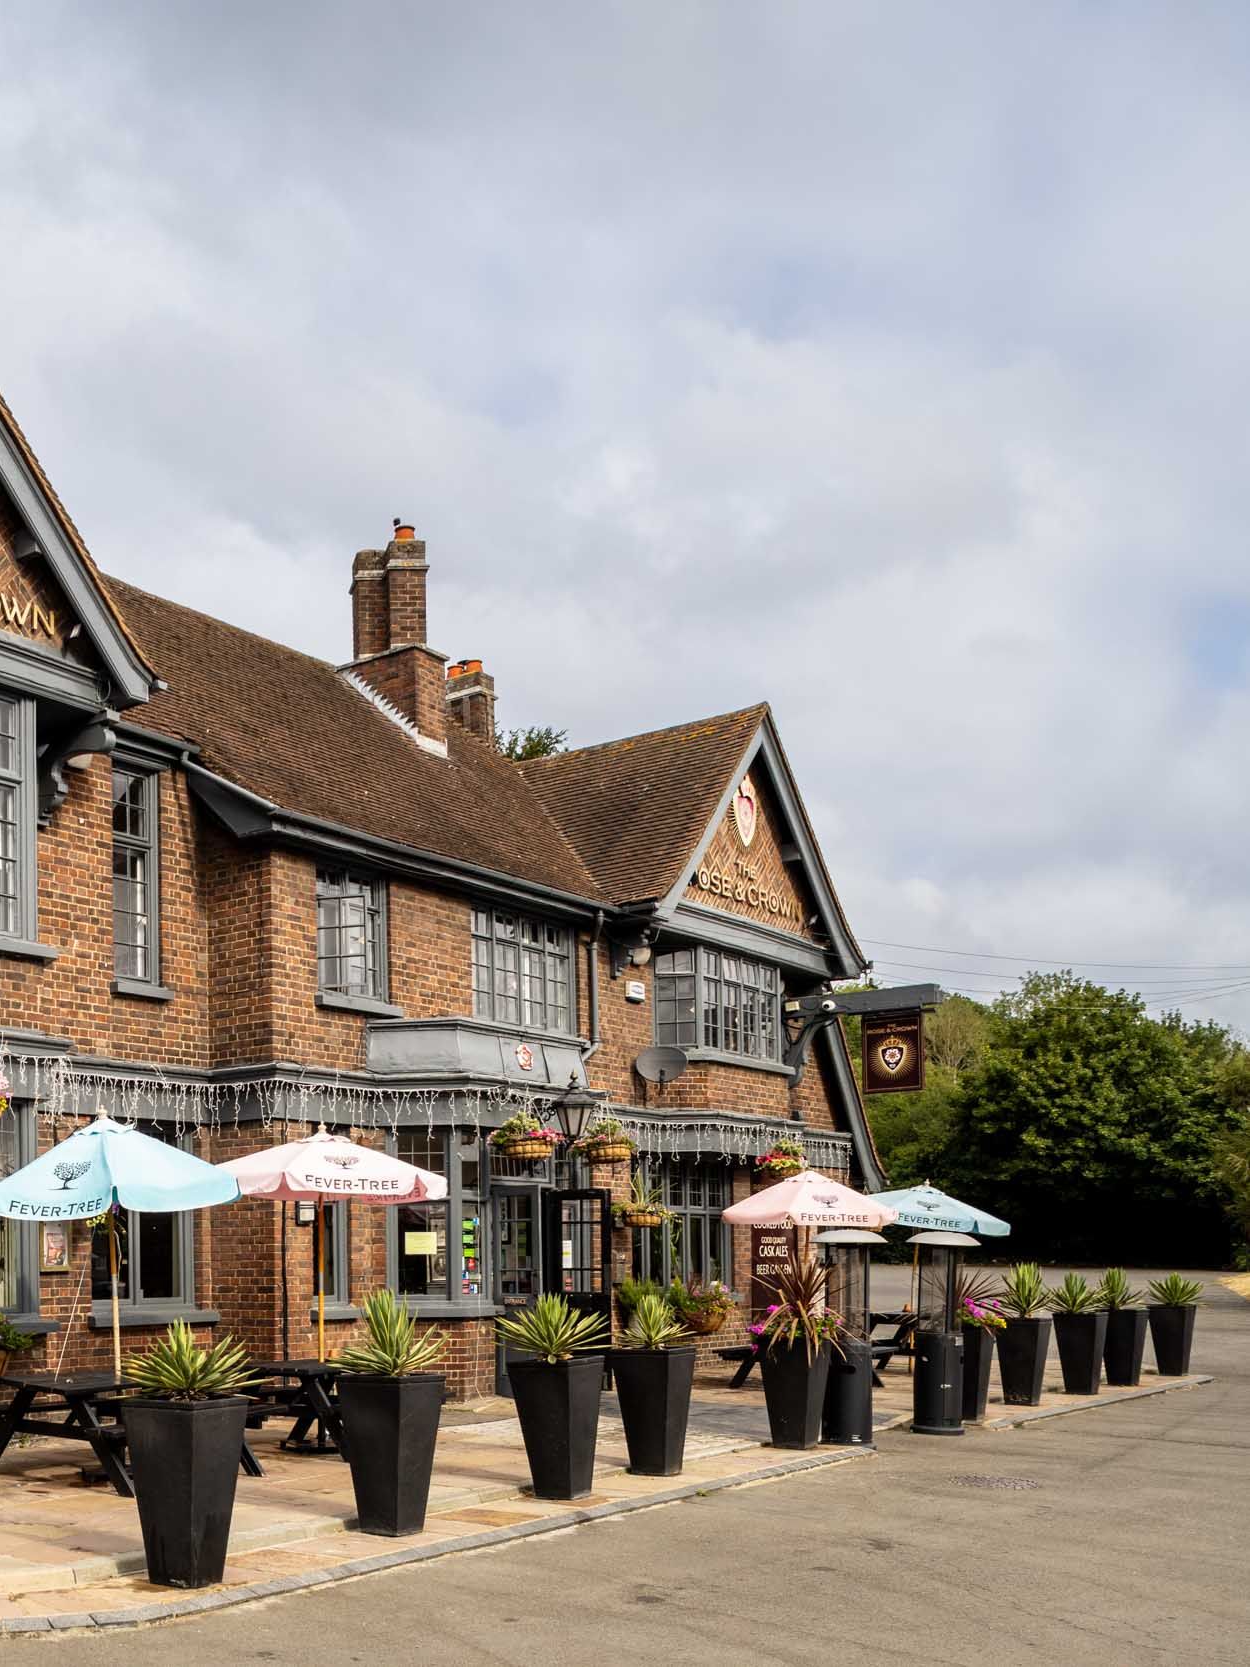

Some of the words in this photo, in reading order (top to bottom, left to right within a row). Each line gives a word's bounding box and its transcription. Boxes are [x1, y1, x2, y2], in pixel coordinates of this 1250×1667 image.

[734, 860, 758, 880] THE
[696, 867, 732, 897] OSE
[735, 881, 747, 900] &
[748, 884, 803, 919] CROWN
[305, 1174, 399, 1191] FEVER-TREE
[8, 1198, 103, 1217] FEVER-TREE
[801, 1212, 869, 1223] FEVER-TREE
[898, 1212, 961, 1228] FEVER-TREE
[759, 1245, 776, 1257] CASK
[775, 1245, 789, 1257] ALES
[756, 1264, 770, 1275] BEER
